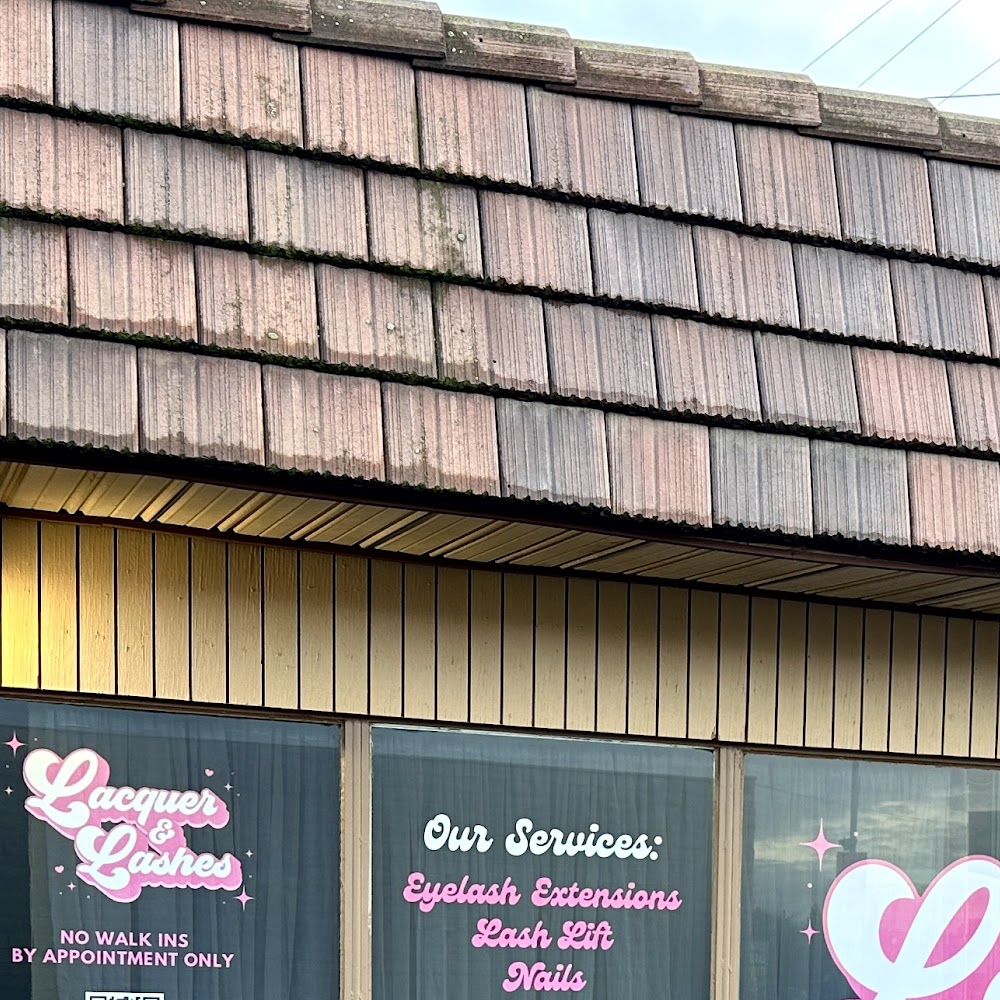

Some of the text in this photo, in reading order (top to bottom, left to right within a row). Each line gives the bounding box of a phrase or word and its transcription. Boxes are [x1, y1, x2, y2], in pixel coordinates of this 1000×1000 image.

[23, 748, 222, 828] Lacquer
[150, 818, 177, 846] &
[423, 813, 663, 861] Our Services:
[75, 823, 236, 892] Lashes
[402, 872, 683, 913] Eyelash Extensions
[60, 929, 189, 948] NO WALK INS
[471, 918, 615, 951] Lash Lift
[11, 948, 234, 968] BY APPOINTMENT ONLY
[502, 961, 587, 993] Nails
